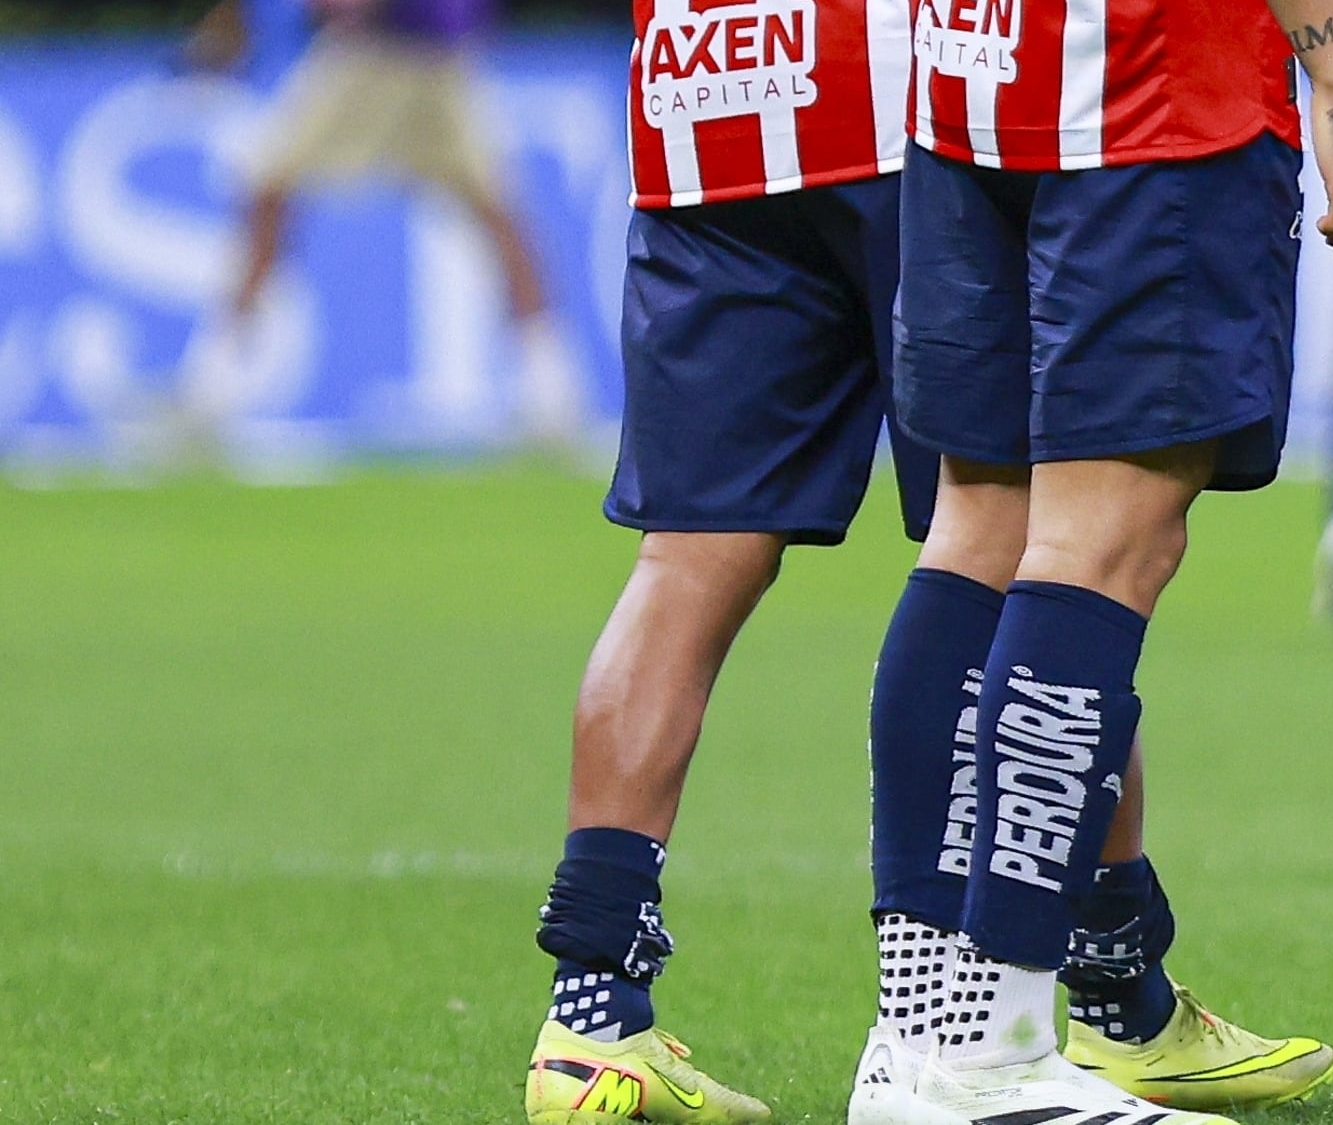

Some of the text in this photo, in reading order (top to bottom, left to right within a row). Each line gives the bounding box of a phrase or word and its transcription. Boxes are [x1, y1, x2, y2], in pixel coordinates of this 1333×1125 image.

[649, 10, 803, 83] AXEN
[650, 75, 806, 116] CAPITAL
[989, 677, 1102, 894] PERDURA
